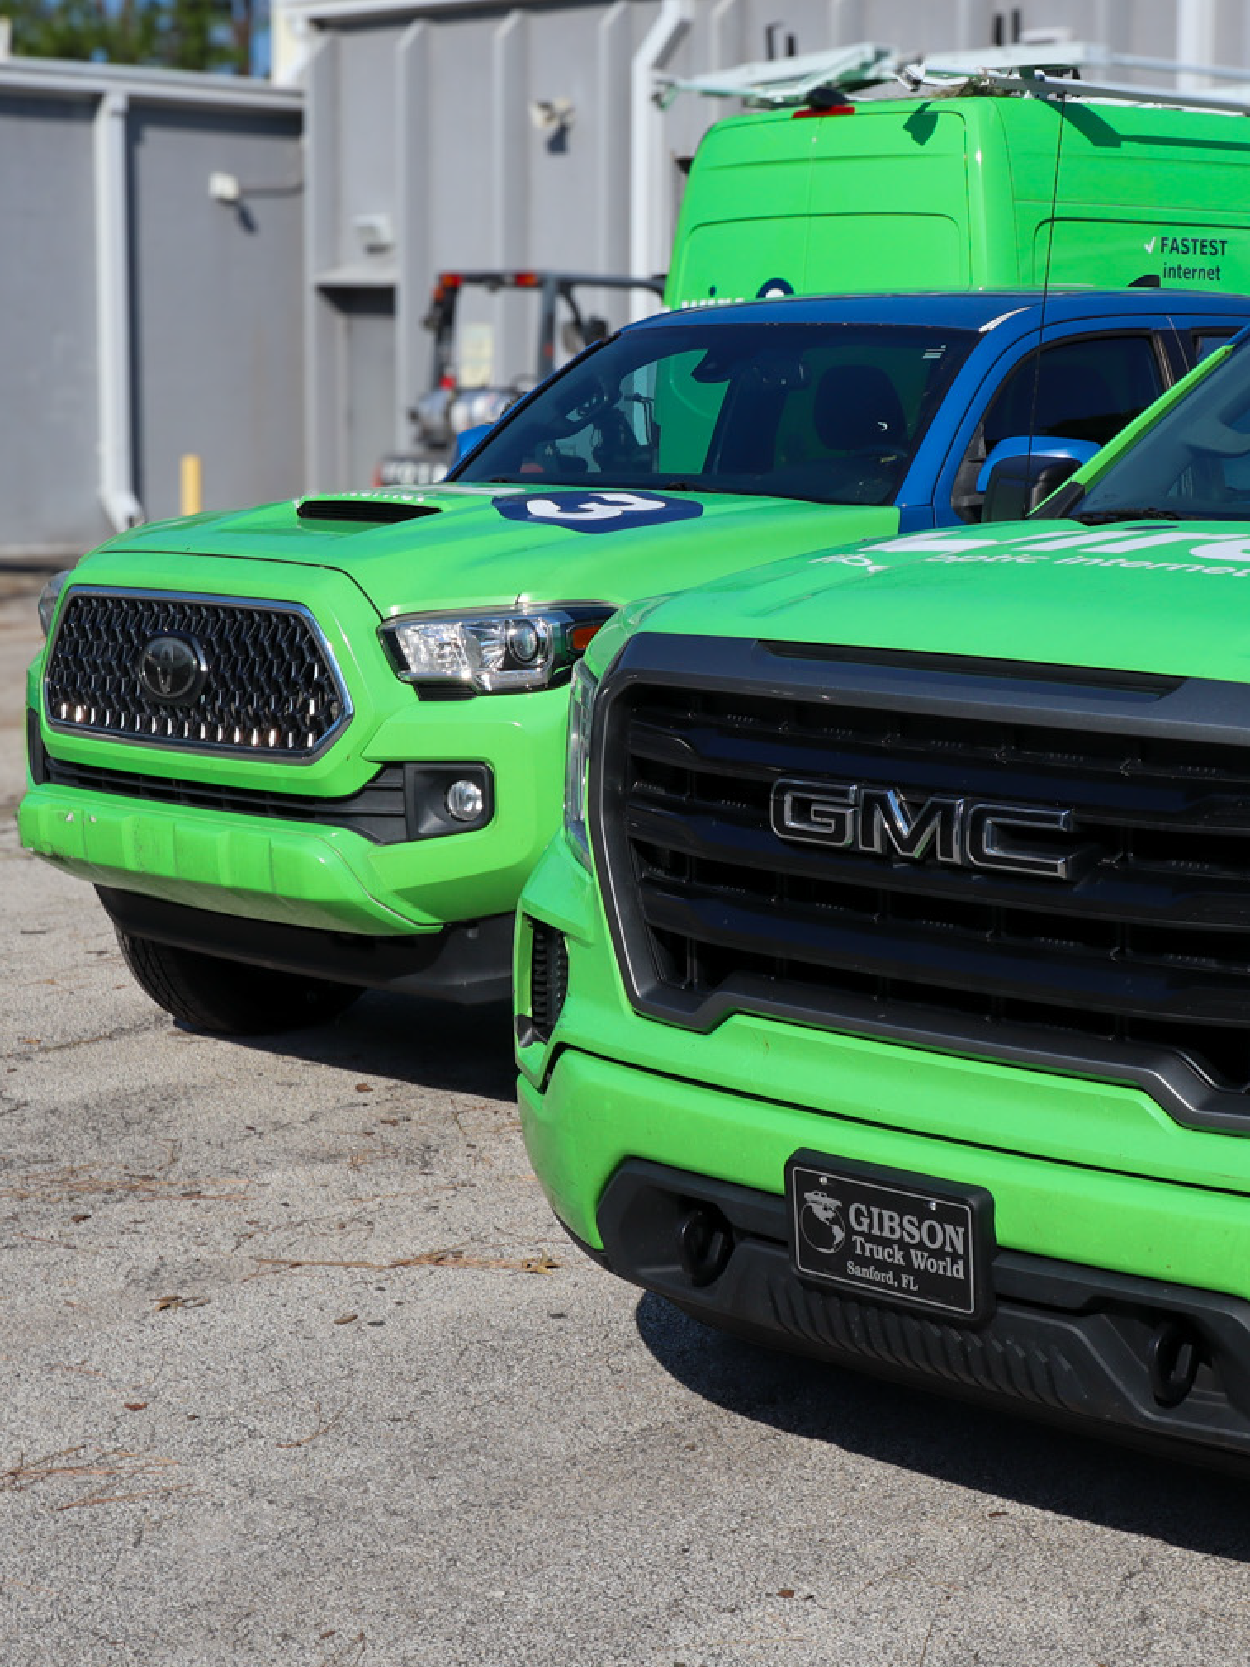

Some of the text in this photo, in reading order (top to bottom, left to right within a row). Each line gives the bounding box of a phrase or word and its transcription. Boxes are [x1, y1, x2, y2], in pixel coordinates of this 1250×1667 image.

[1160, 236, 1228, 256] FASTEST
[1162, 263, 1221, 281] internet
[526, 492, 666, 521] 3
[771, 778, 1072, 880] GMC
[848, 1202, 965, 1255] GIBSON
[852, 1236, 965, 1280] Truck World
[846, 1260, 919, 1291] Sanford, FL
